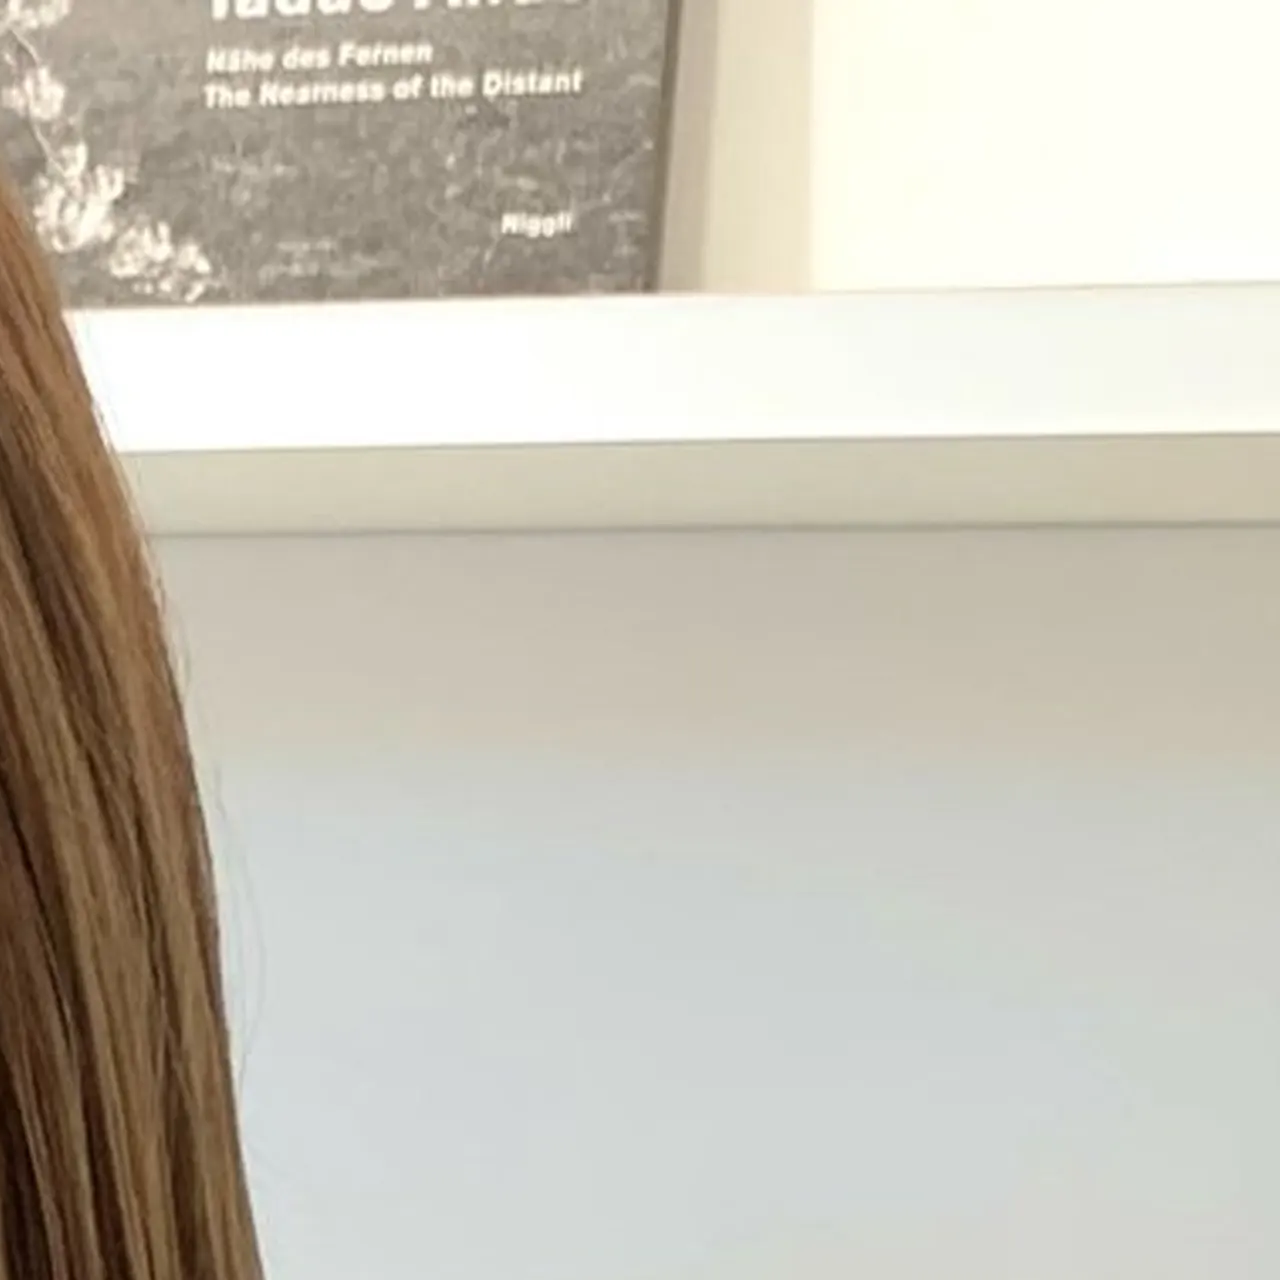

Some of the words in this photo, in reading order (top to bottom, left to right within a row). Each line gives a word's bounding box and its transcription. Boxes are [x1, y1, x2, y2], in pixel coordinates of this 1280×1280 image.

[282, 43, 331, 70] des
[338, 41, 433, 67] Fernen
[203, 82, 251, 109] The
[258, 79, 386, 107] Nearness
[392, 72, 424, 100] of
[429, 72, 474, 98] the
[482, 69, 584, 97] Distant
